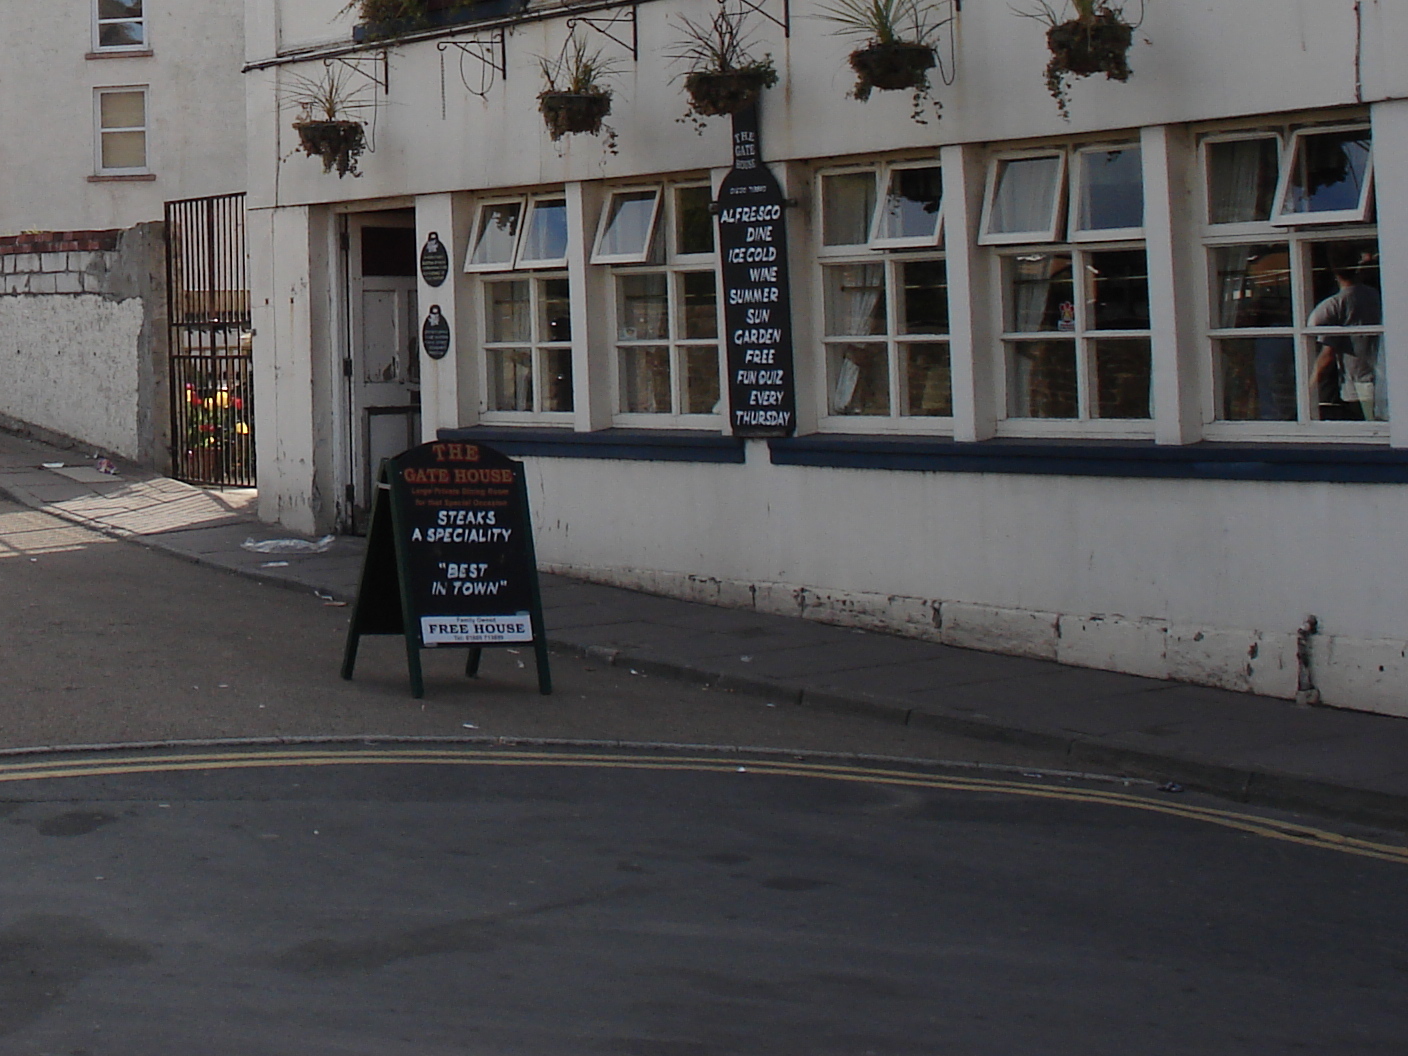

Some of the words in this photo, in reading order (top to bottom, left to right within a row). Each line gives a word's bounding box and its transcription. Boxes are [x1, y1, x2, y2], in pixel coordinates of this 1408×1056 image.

[734, 131, 755, 144] THE
[735, 144, 755, 156] GATE
[720, 205, 781, 223] ALFRESCO
[746, 226, 773, 242] DINE
[729, 247, 746, 263] ICE
[746, 246, 777, 262] COLD
[749, 266, 778, 282] WINE
[729, 287, 779, 304] SUMMER
[746, 309, 770, 324] SUN
[734, 329, 781, 345] GARDEN
[745, 349, 775, 364] FREE
[737, 370, 757, 384] FUN
[758, 370, 783, 385] QUIZ
[749, 390, 784, 405] EVERY
[736, 411, 790, 425] THURSDAY
[433, 443, 480, 462] THE
[403, 468, 450, 483] GATE
[454, 468, 513, 483] HOUSE
[437, 510, 496, 525] STEAKS
[412, 527, 422, 542] A
[427, 527, 512, 542] SPECIALITY
[432, 581, 447, 595] IN
[428, 624, 469, 634] FREE
[474, 623, 526, 634] HOUSE
